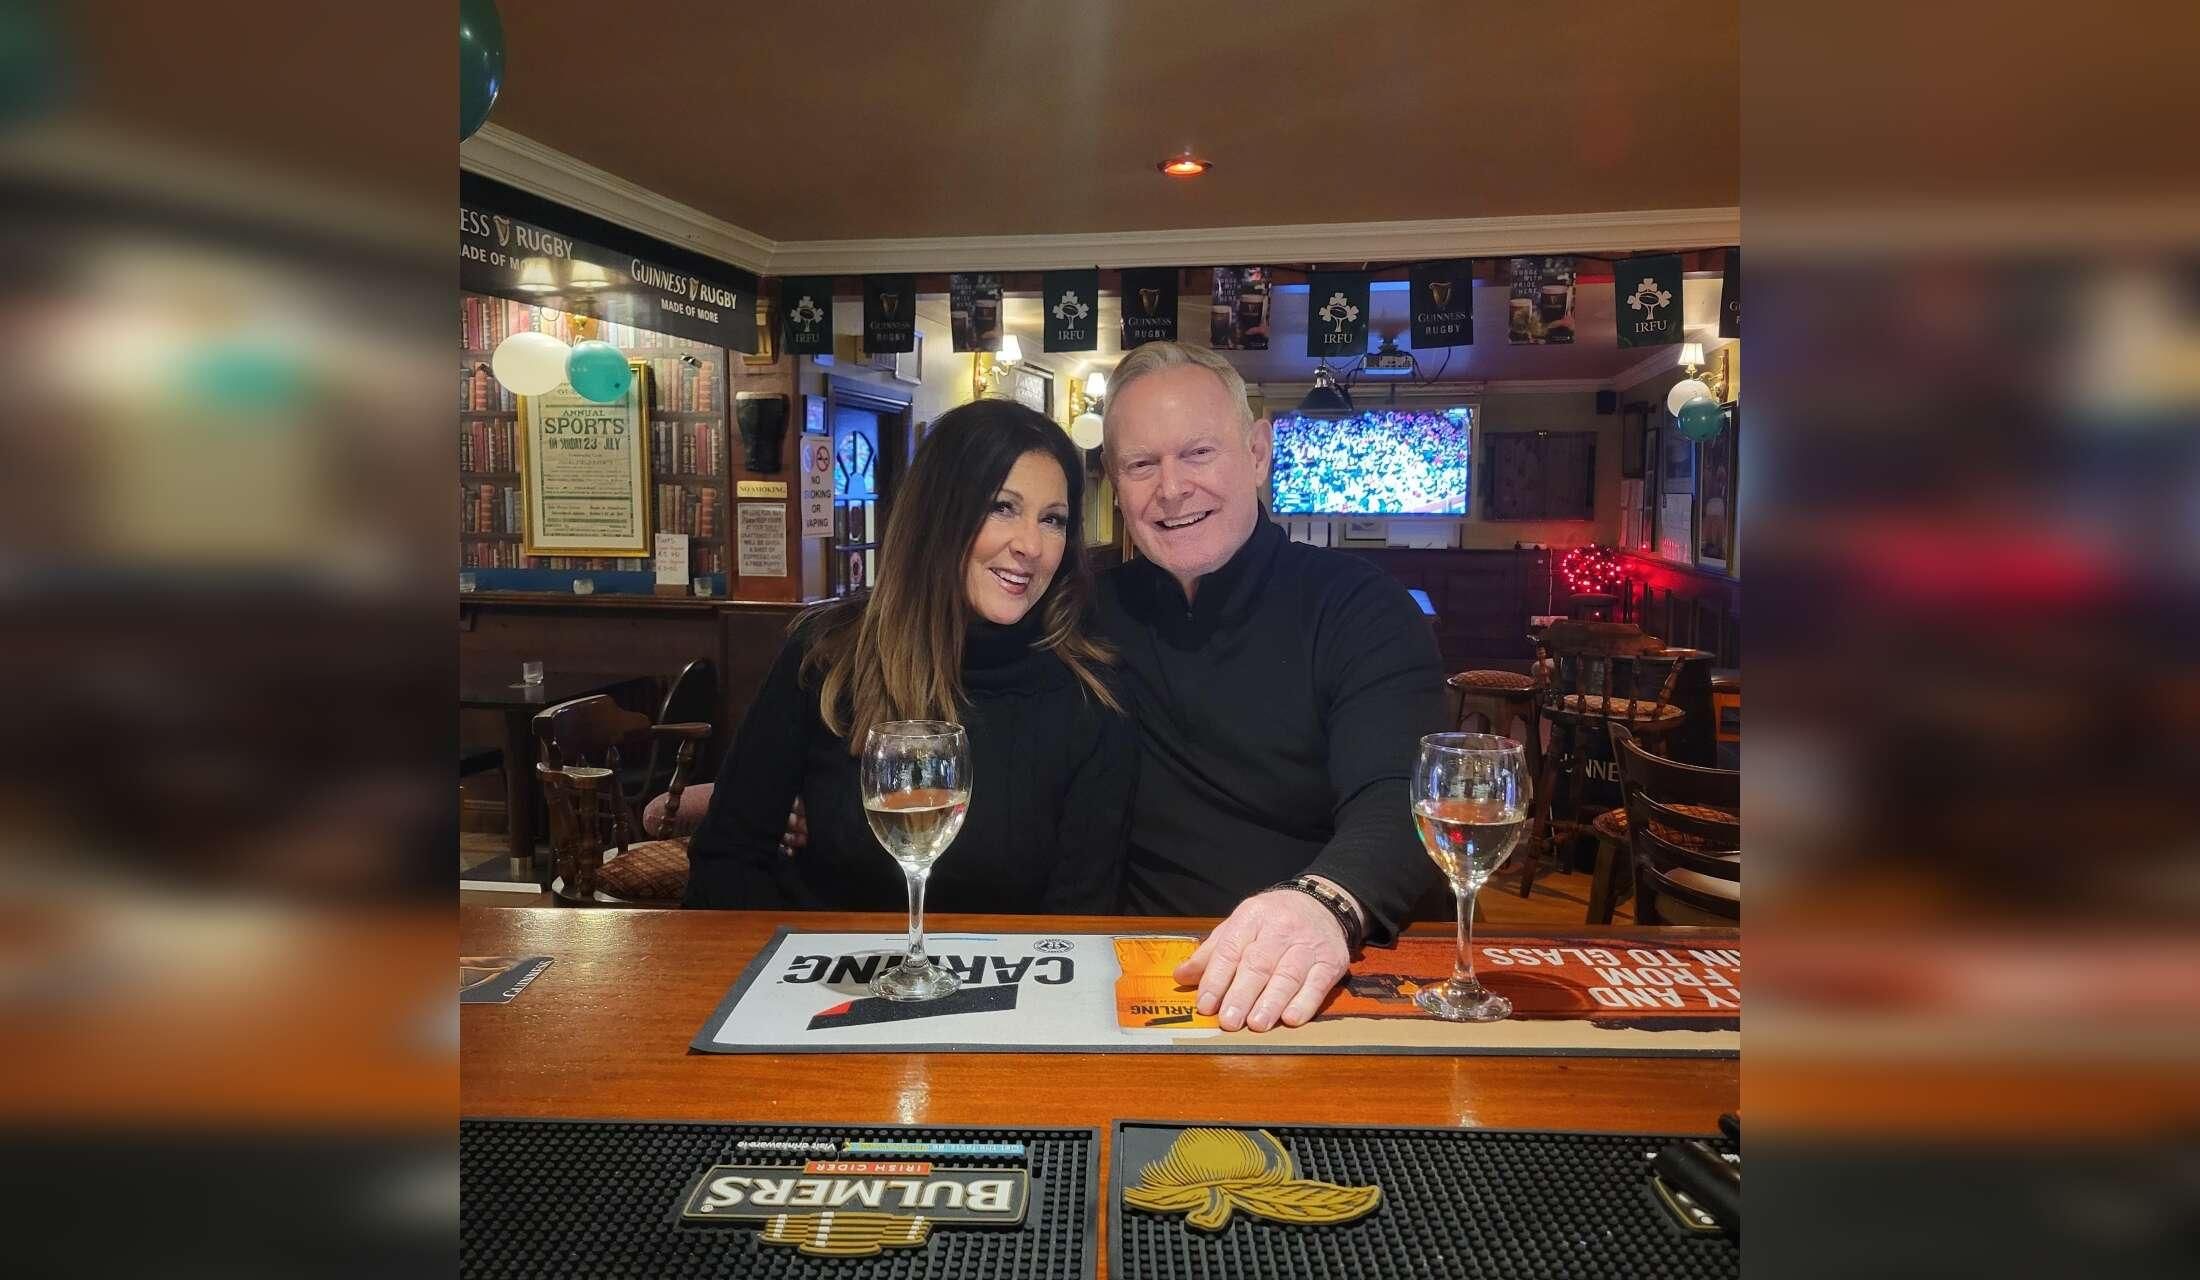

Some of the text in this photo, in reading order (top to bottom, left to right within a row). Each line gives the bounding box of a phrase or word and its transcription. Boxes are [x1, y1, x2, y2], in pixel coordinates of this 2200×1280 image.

[515, 225, 573, 260] RUGBY
[490, 252, 506, 267] OF
[631, 258, 737, 310] GUINNESS RUGBY
[661, 298, 719, 324] MADE OF MORE
[1418, 311, 1466, 322] GUINNESS
[1128, 316, 1172, 327] GUINNESS
[1635, 320, 1668, 333] IRFU
[1058, 330, 1085, 340] IRFU
[1135, 329, 1167, 338] RUGBY
[1425, 324, 1460, 335] RUGBY
[1324, 333, 1353, 344] IRFU
[562, 409, 606, 417] ANNUAL
[544, 417, 625, 435] SPORTS
[583, 438, 597, 450] 23
[604, 438, 620, 450] JULY
[811, 504, 821, 514] OR
[1482, 948, 1622, 966] GLASS
[1629, 949, 1692, 967] TO
[1594, 967, 1727, 987] FROM
[1588, 987, 1686, 1008] AND
[1130, 1005, 1198, 1015] ARLING
[812, 1141, 836, 1151] Visit
[816, 1162, 922, 1173] IRISH CIDER
[709, 1176, 1016, 1212] BULMERS
